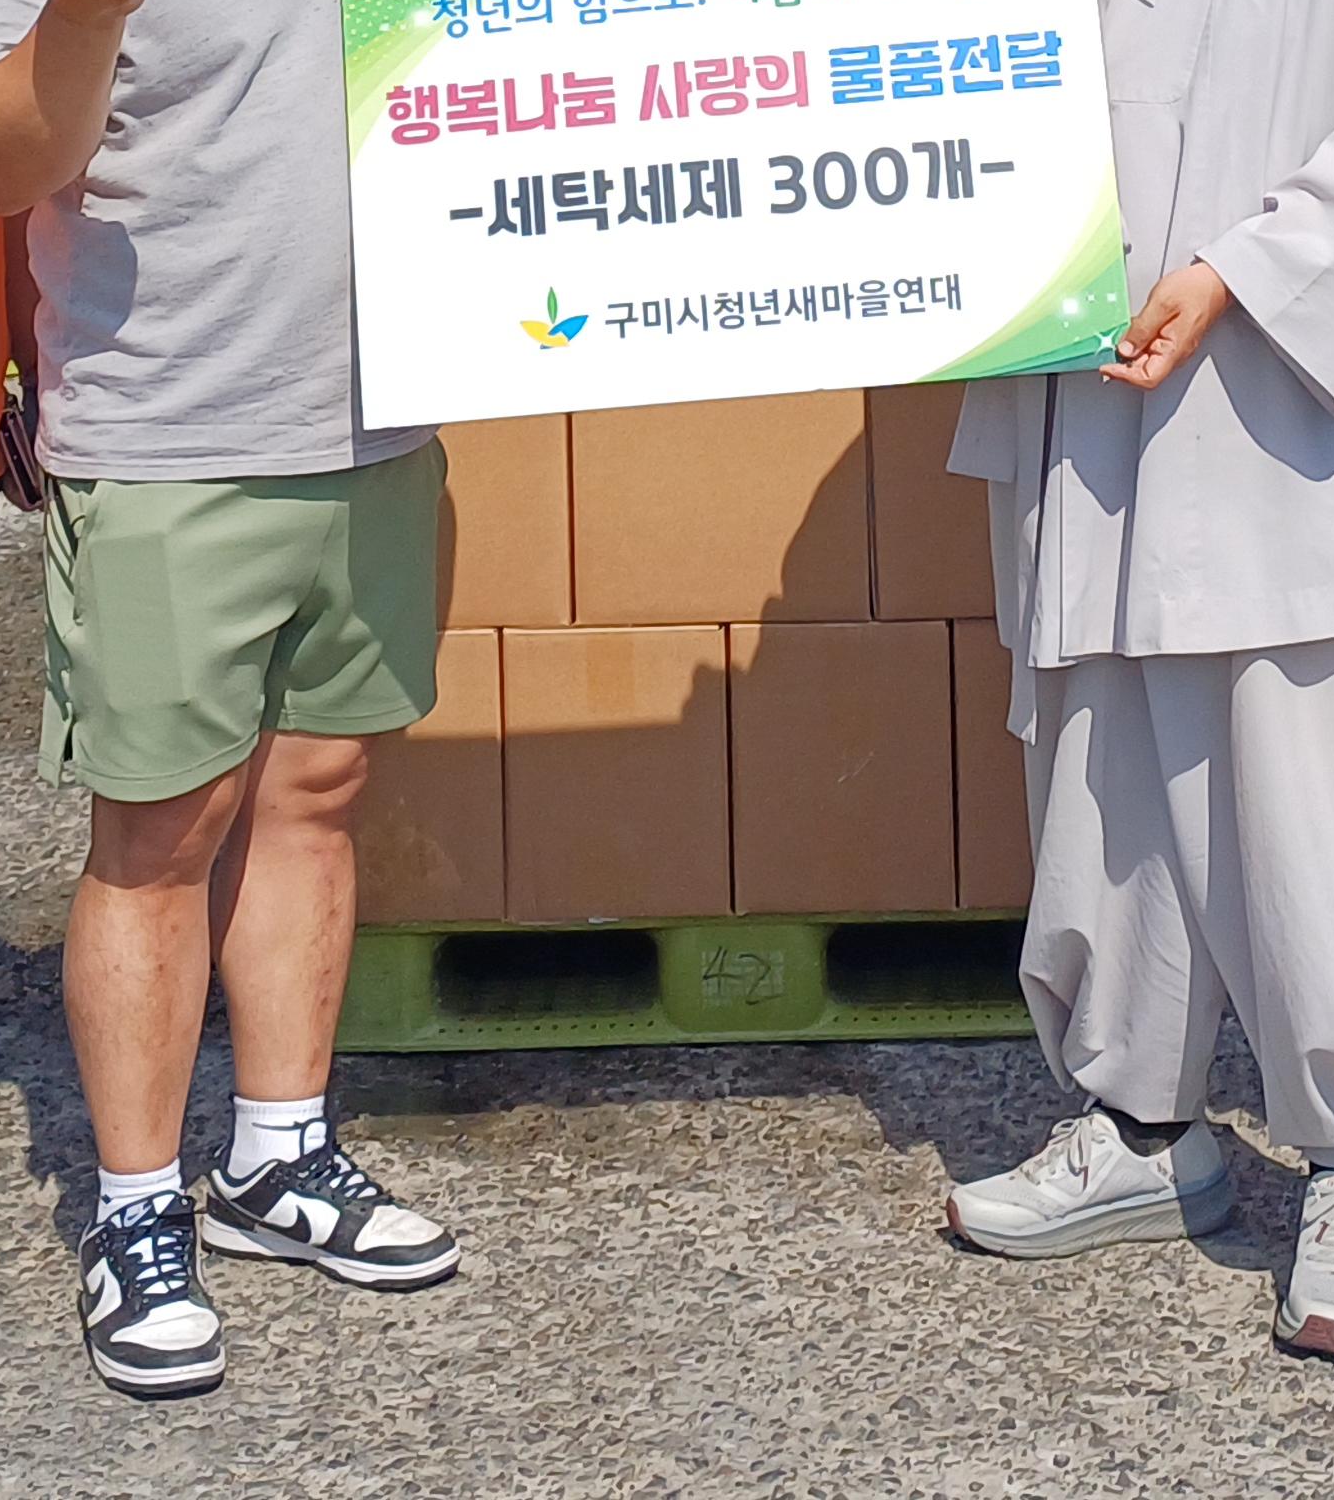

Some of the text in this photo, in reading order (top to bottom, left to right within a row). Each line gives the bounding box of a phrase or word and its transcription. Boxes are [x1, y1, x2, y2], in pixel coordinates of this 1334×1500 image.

[385, 29, 1064, 147] 행복나눔 사랑의 물품전달
[448, 137, 1016, 238] -세탁세제 300개-
[604, 272, 963, 340] 구미시청년새마을연대
